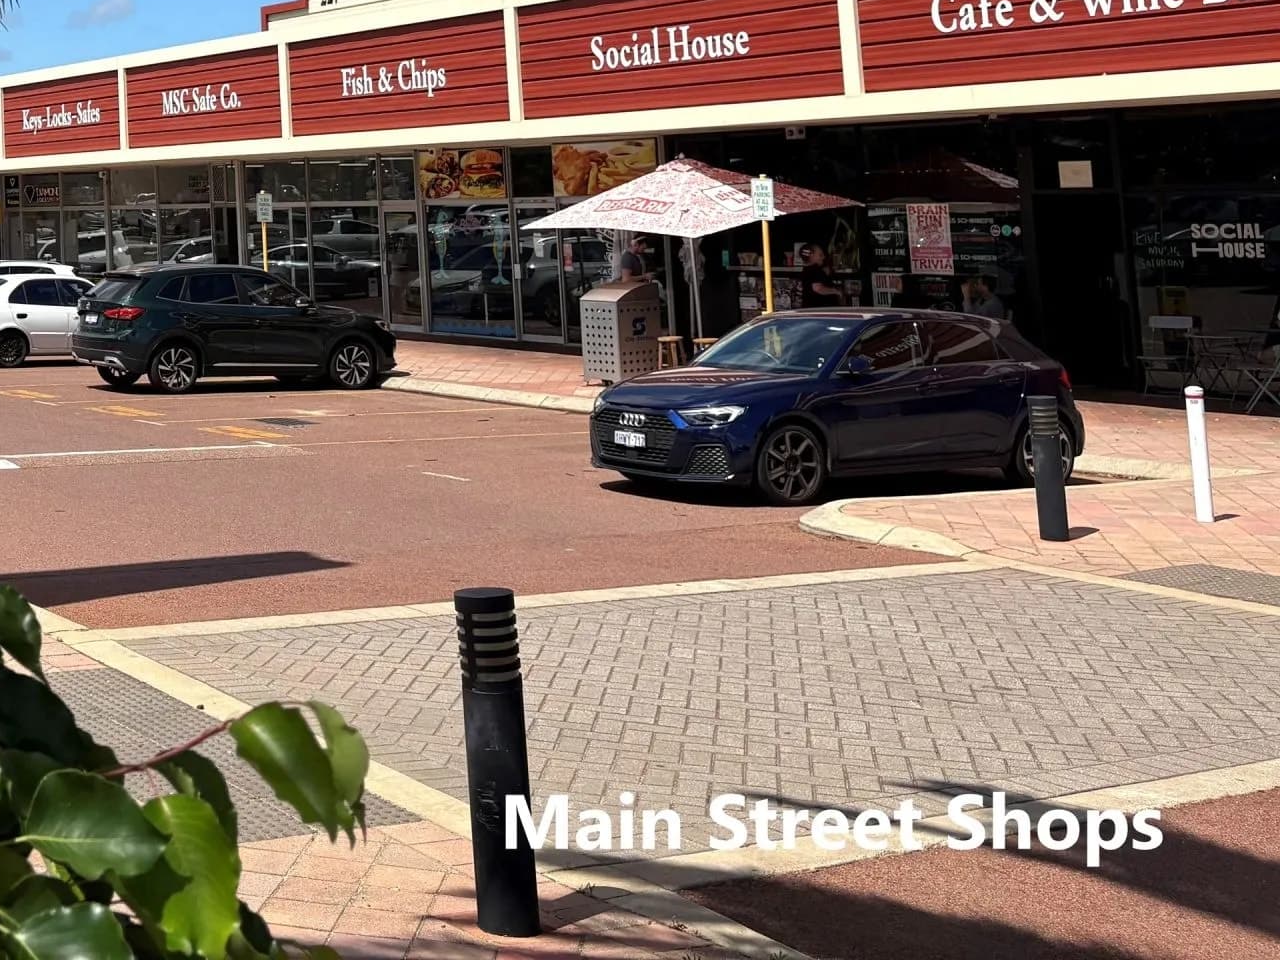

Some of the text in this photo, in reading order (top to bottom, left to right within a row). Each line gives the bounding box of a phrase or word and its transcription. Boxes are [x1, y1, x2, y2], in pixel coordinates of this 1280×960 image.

[590, 25, 750, 71] Social House
[340, 58, 447, 97] Fish & Chips
[161, 82, 242, 116] MSC Safe Co.
[22, 100, 101, 135] Keys-Locks-Safes
[908, 205, 948, 215] BRAIN
[917, 215, 943, 227] FUN
[1190, 223, 1265, 239] SOCIAL
[1191, 242, 1266, 258] HOUSE
[912, 258, 953, 270] TRIVIA
